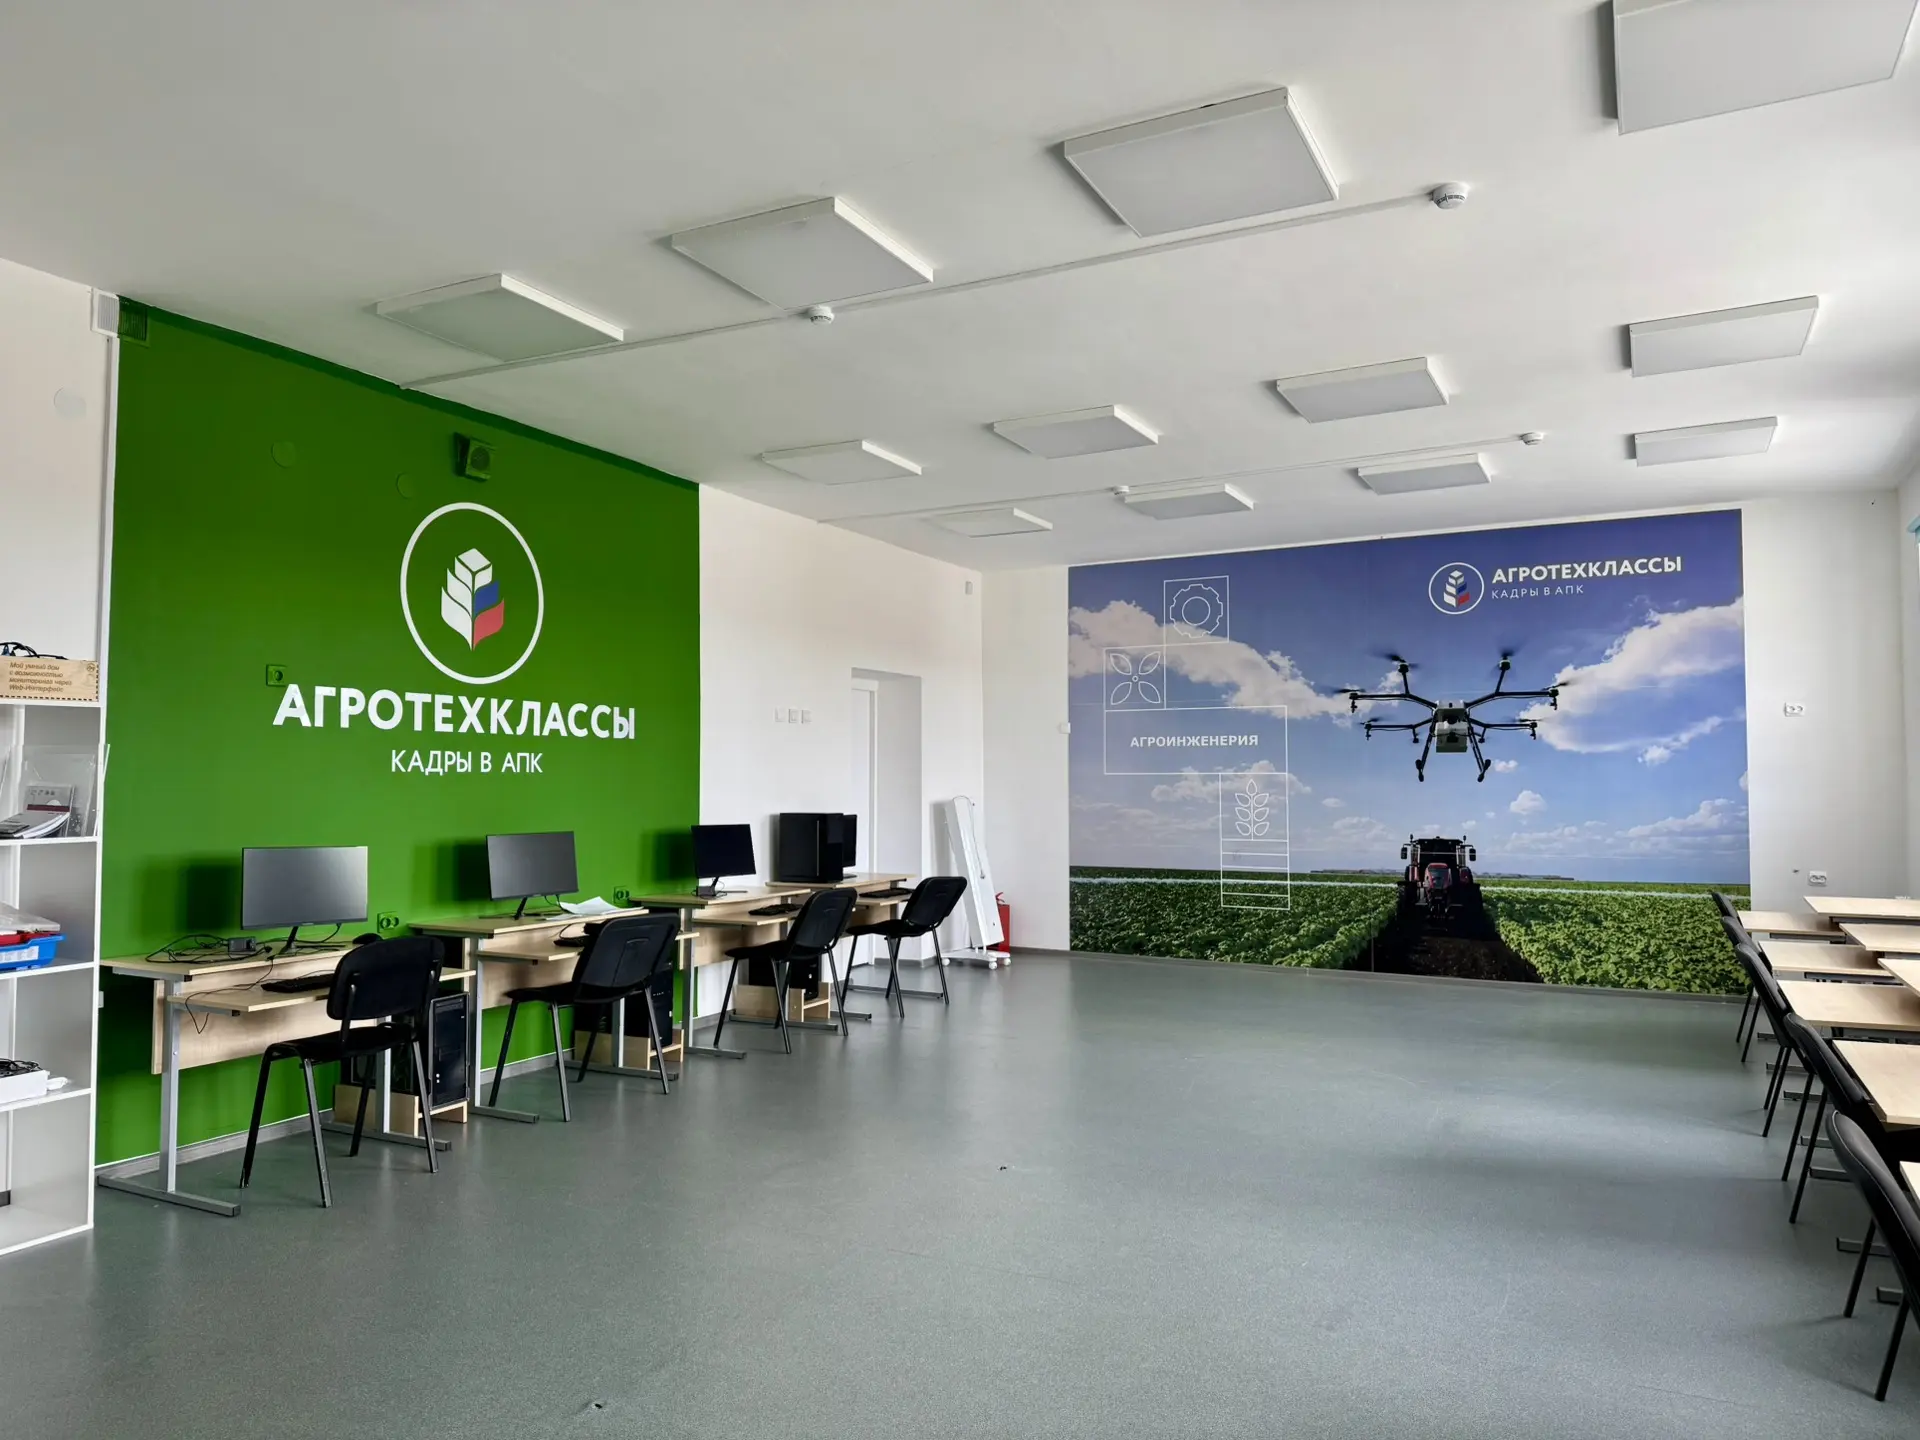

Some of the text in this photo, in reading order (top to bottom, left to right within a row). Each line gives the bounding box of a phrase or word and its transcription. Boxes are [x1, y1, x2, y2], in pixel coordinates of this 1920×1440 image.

[1491, 556, 1682, 584] АГРОТЕХКЛАССЫ
[1491, 585, 1584, 599] КАДРЫ В АПК
[273, 683, 635, 740] АГРОТЕХКЛАССЫ
[1130, 734, 1259, 748] АГРОИНЖЕНЕРИЯ
[391, 749, 543, 776] КАДРЫ В АПК
